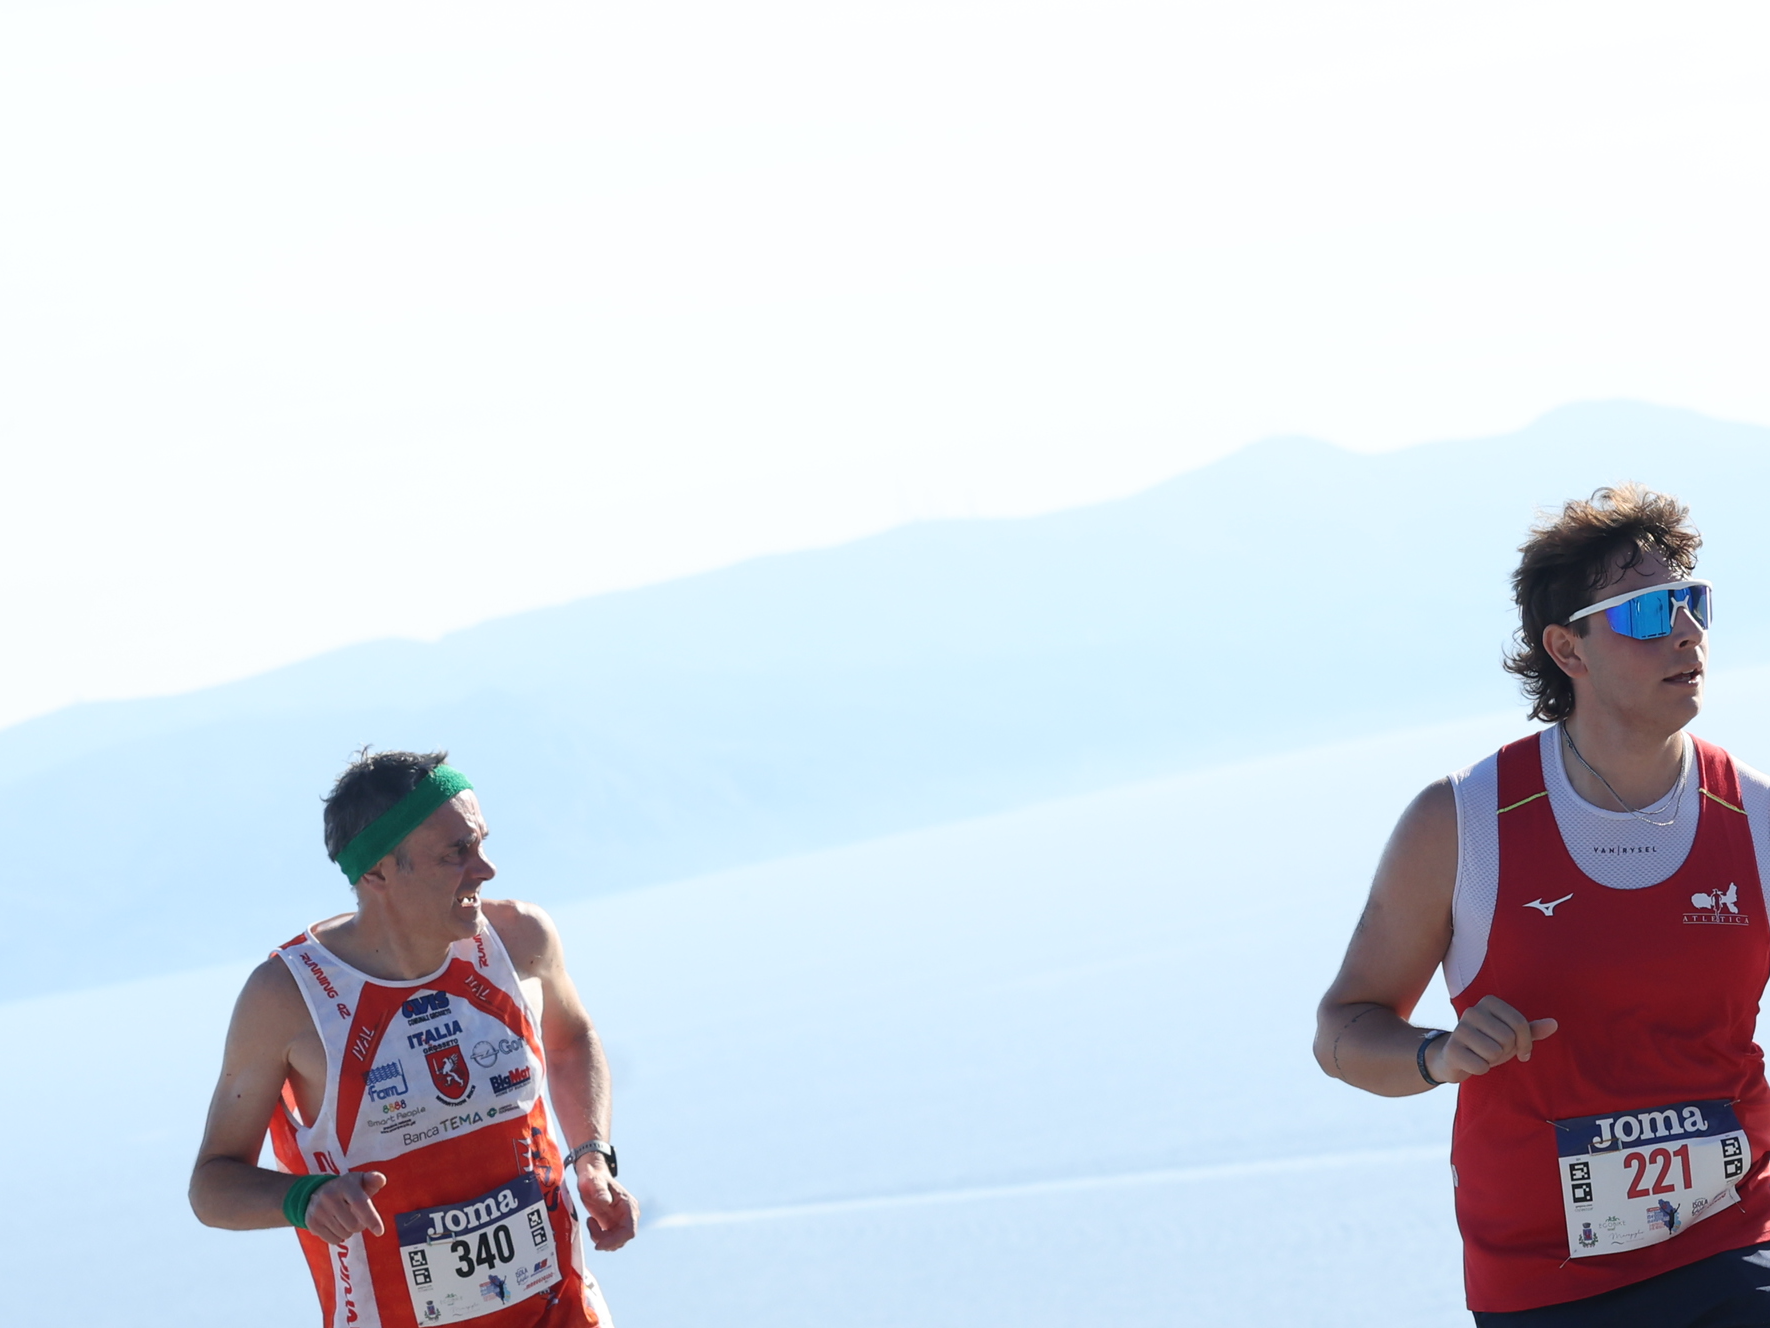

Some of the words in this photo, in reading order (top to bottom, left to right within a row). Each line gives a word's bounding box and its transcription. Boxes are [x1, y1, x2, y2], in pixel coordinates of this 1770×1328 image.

[1622, 846, 1657, 854] RYSEL
[1683, 915, 1749, 924] ATLETICA
[300, 952, 339, 999] RUNNING
[402, 990, 450, 1018] AVIS
[407, 1020, 463, 1049] ITALIA
[423, 1038, 459, 1054] GROSSETO
[489, 1066, 531, 1092] BigMat
[367, 1114, 396, 1128] Smart
[396, 1105, 426, 1121] People
[403, 1126, 440, 1146] Banca
[440, 1112, 484, 1133] TEMA
[1592, 1106, 1709, 1148] Joma
[1623, 1144, 1693, 1200] 221
[427, 1189, 518, 1238] Joma
[450, 1224, 515, 1279] 340
